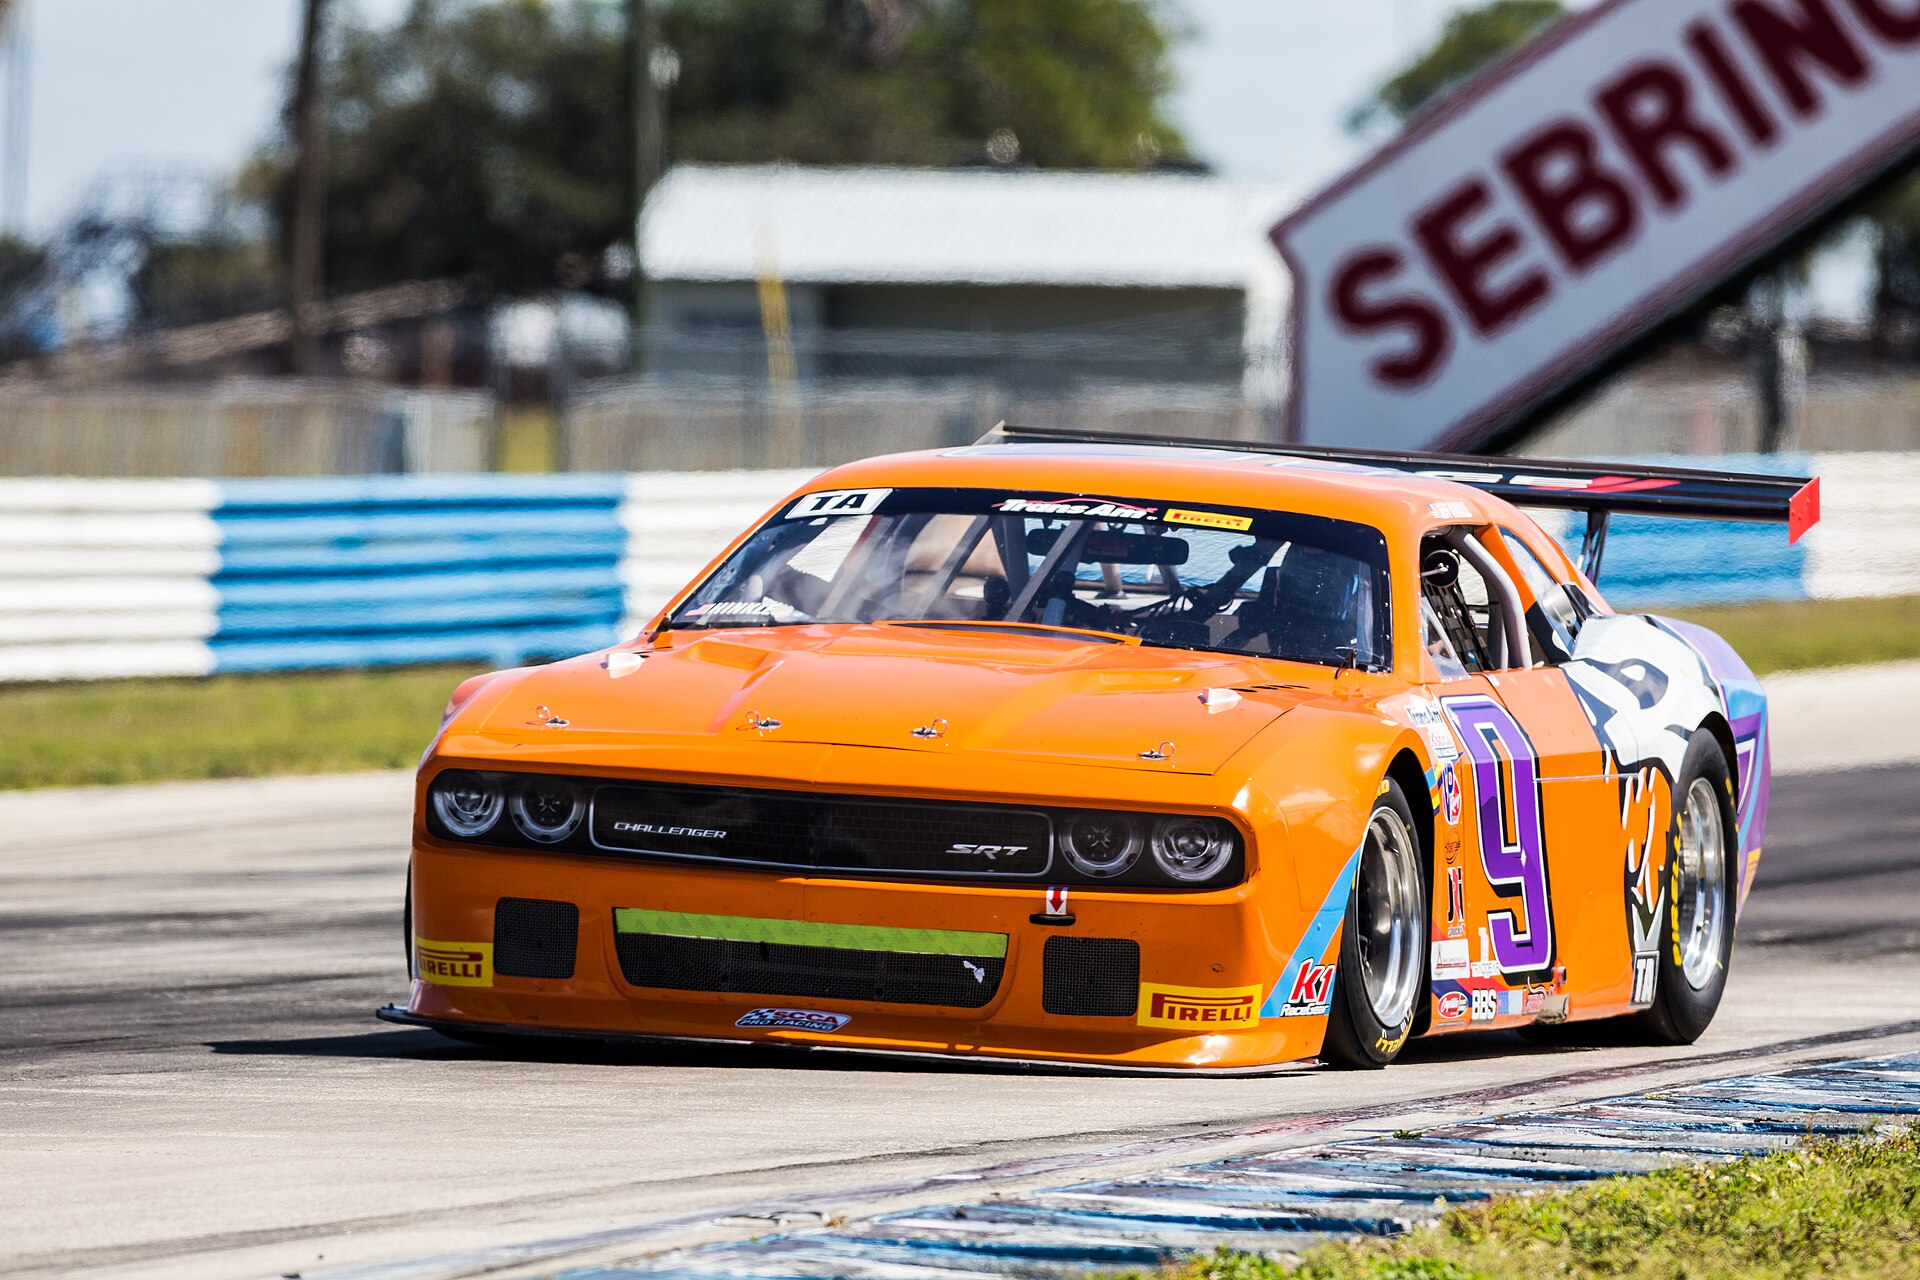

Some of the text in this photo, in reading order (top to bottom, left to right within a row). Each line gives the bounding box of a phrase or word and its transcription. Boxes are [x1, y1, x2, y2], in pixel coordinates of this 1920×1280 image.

[809, 493, 868, 511] TA
[1000, 499, 1148, 520] Trans Am
[613, 821, 728, 839] CHALLENGER
[1439, 693, 1555, 975] 9
[944, 843, 1029, 860] SRT
[1289, 960, 1336, 1004] K1
[1634, 959, 1656, 1003] TA
[1150, 992, 1255, 1022] PIRELLI
[1280, 1003, 1330, 1017] RaceGear
[1471, 989, 1497, 1020] BBS
[773, 1011, 839, 1025] SCCA
[774, 1020, 833, 1031] RACING
